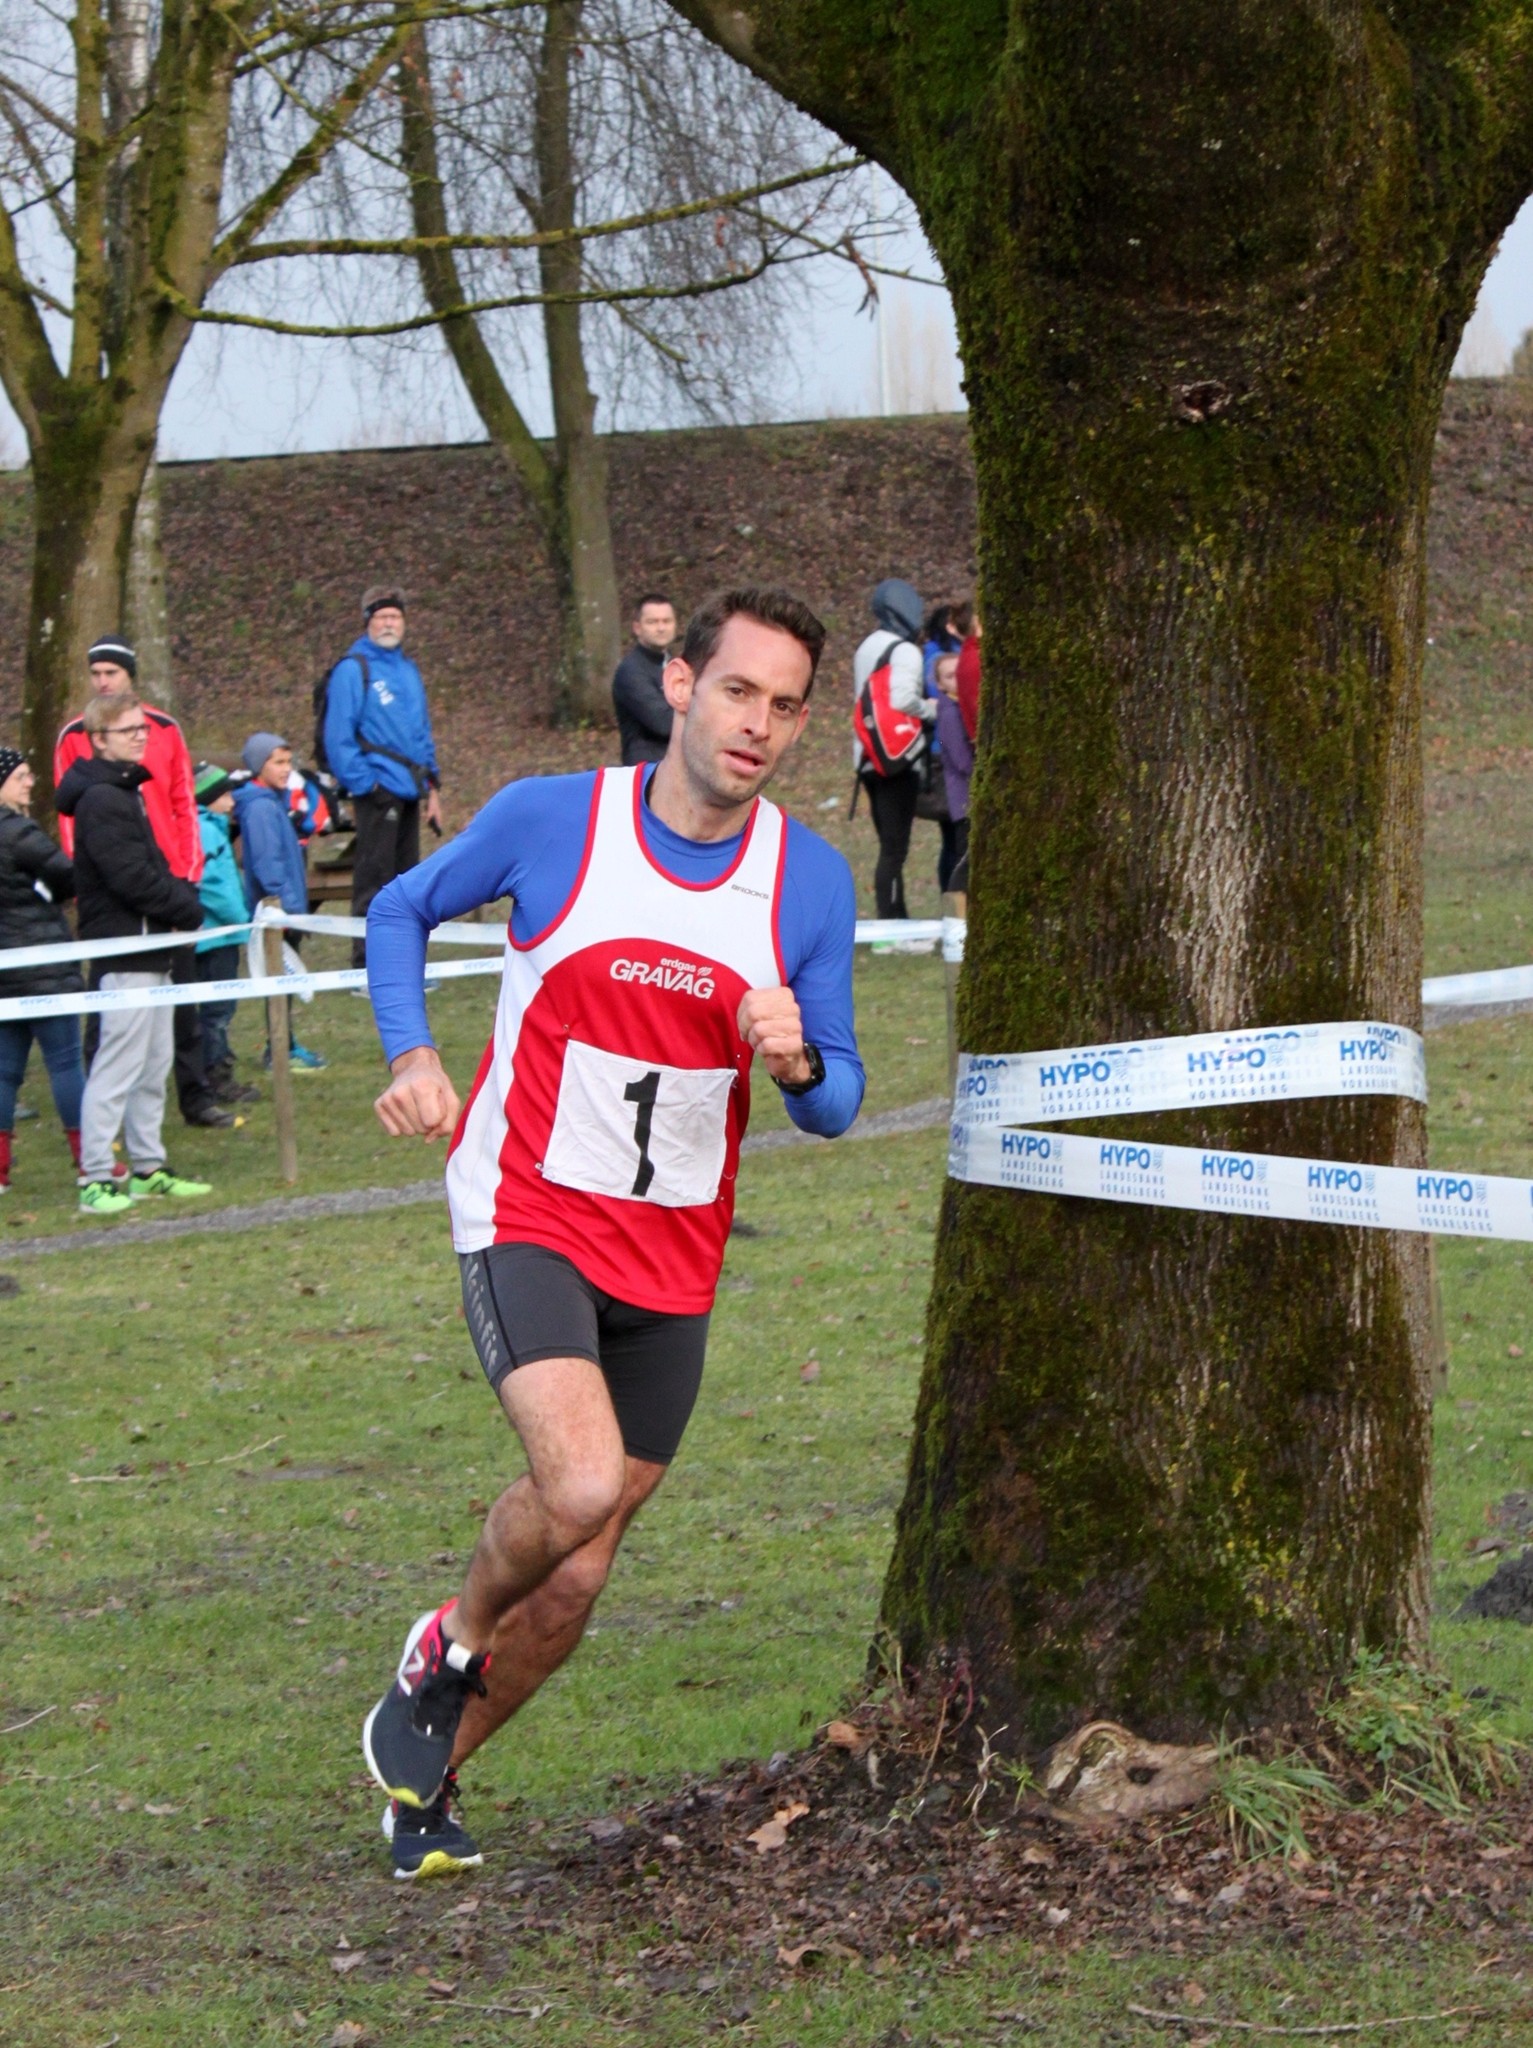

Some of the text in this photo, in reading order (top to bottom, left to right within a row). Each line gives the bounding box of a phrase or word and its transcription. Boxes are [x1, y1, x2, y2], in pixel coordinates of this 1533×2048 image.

[731, 884, 770, 900] BROOKS
[660, 957, 696, 973] erdgas
[609, 958, 715, 999] GRAVAG
[1340, 1040, 1387, 1061] HYPO
[1187, 1048, 1266, 1072] HYPO
[1040, 1061, 1111, 1087] HYPO
[1188, 1071, 1286, 1087] LANDESBANK
[1041, 1084, 1131, 1102] LANDESBANK
[1190, 1083, 1288, 1101] VORARLBERG
[1042, 1098, 1132, 1115] VORARLBERG
[623, 1071, 661, 1197] 1
[1002, 1133, 1050, 1159] HYPO
[1100, 1144, 1150, 1170] HYPO
[1001, 1159, 1063, 1175] LANDESBANK
[1202, 1155, 1254, 1181] HYPO
[1001, 1171, 1064, 1188] VORARLBERG
[1100, 1169, 1165, 1186] LANDESBANK
[1308, 1166, 1362, 1192] HYPO
[1101, 1183, 1166, 1200] VORARLBERG
[1202, 1180, 1269, 1198] LANDESBANK
[1417, 1176, 1473, 1202] HYPO
[1204, 1194, 1271, 1212] VORARLBERG
[1308, 1191, 1378, 1209] LANDESBANK
[1310, 1206, 1380, 1223] VORARLBERG
[1417, 1202, 1490, 1219] LANDESBANK
[1420, 1216, 1493, 1233] VORARLBERG
